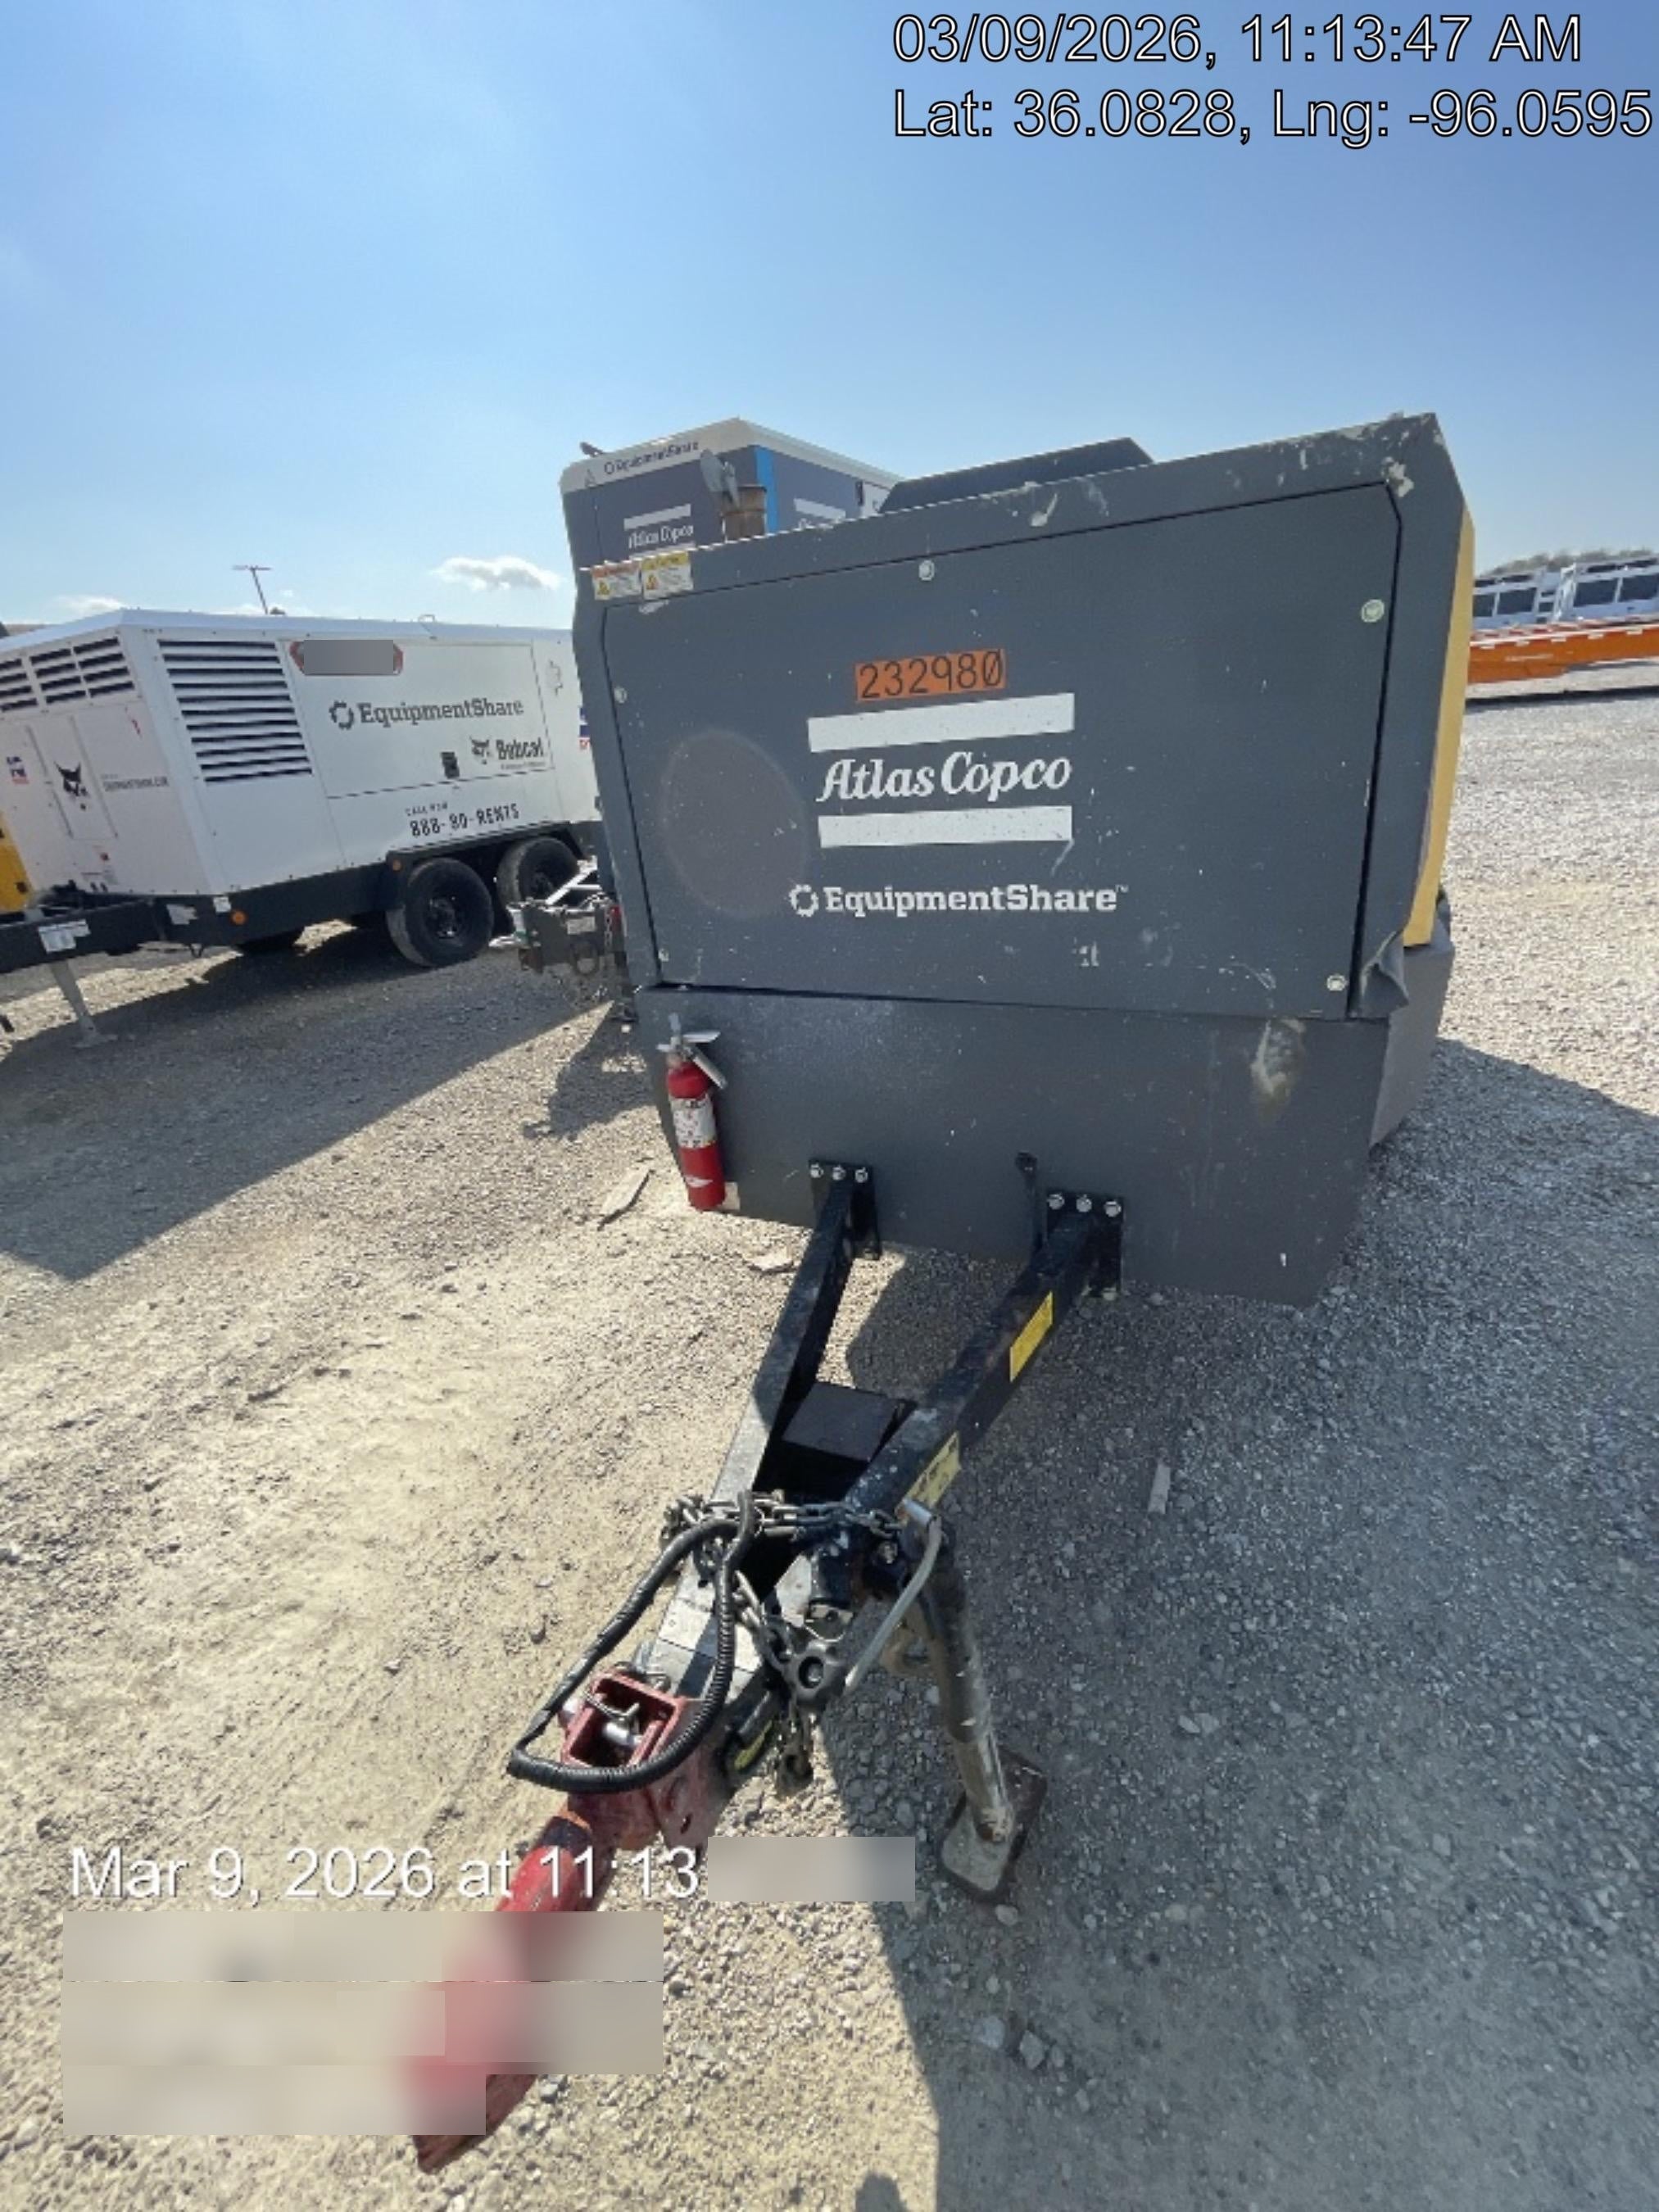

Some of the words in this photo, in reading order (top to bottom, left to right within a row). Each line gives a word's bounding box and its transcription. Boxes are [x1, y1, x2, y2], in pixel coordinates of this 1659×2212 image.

[859, 650, 1004, 699] 232980
[357, 698, 524, 728] EquipmentShare
[496, 737, 544, 760] Bobcat
[816, 758, 935, 802] Atlas
[941, 751, 1072, 802] Copco
[823, 884, 1117, 918] EquipmentShare
